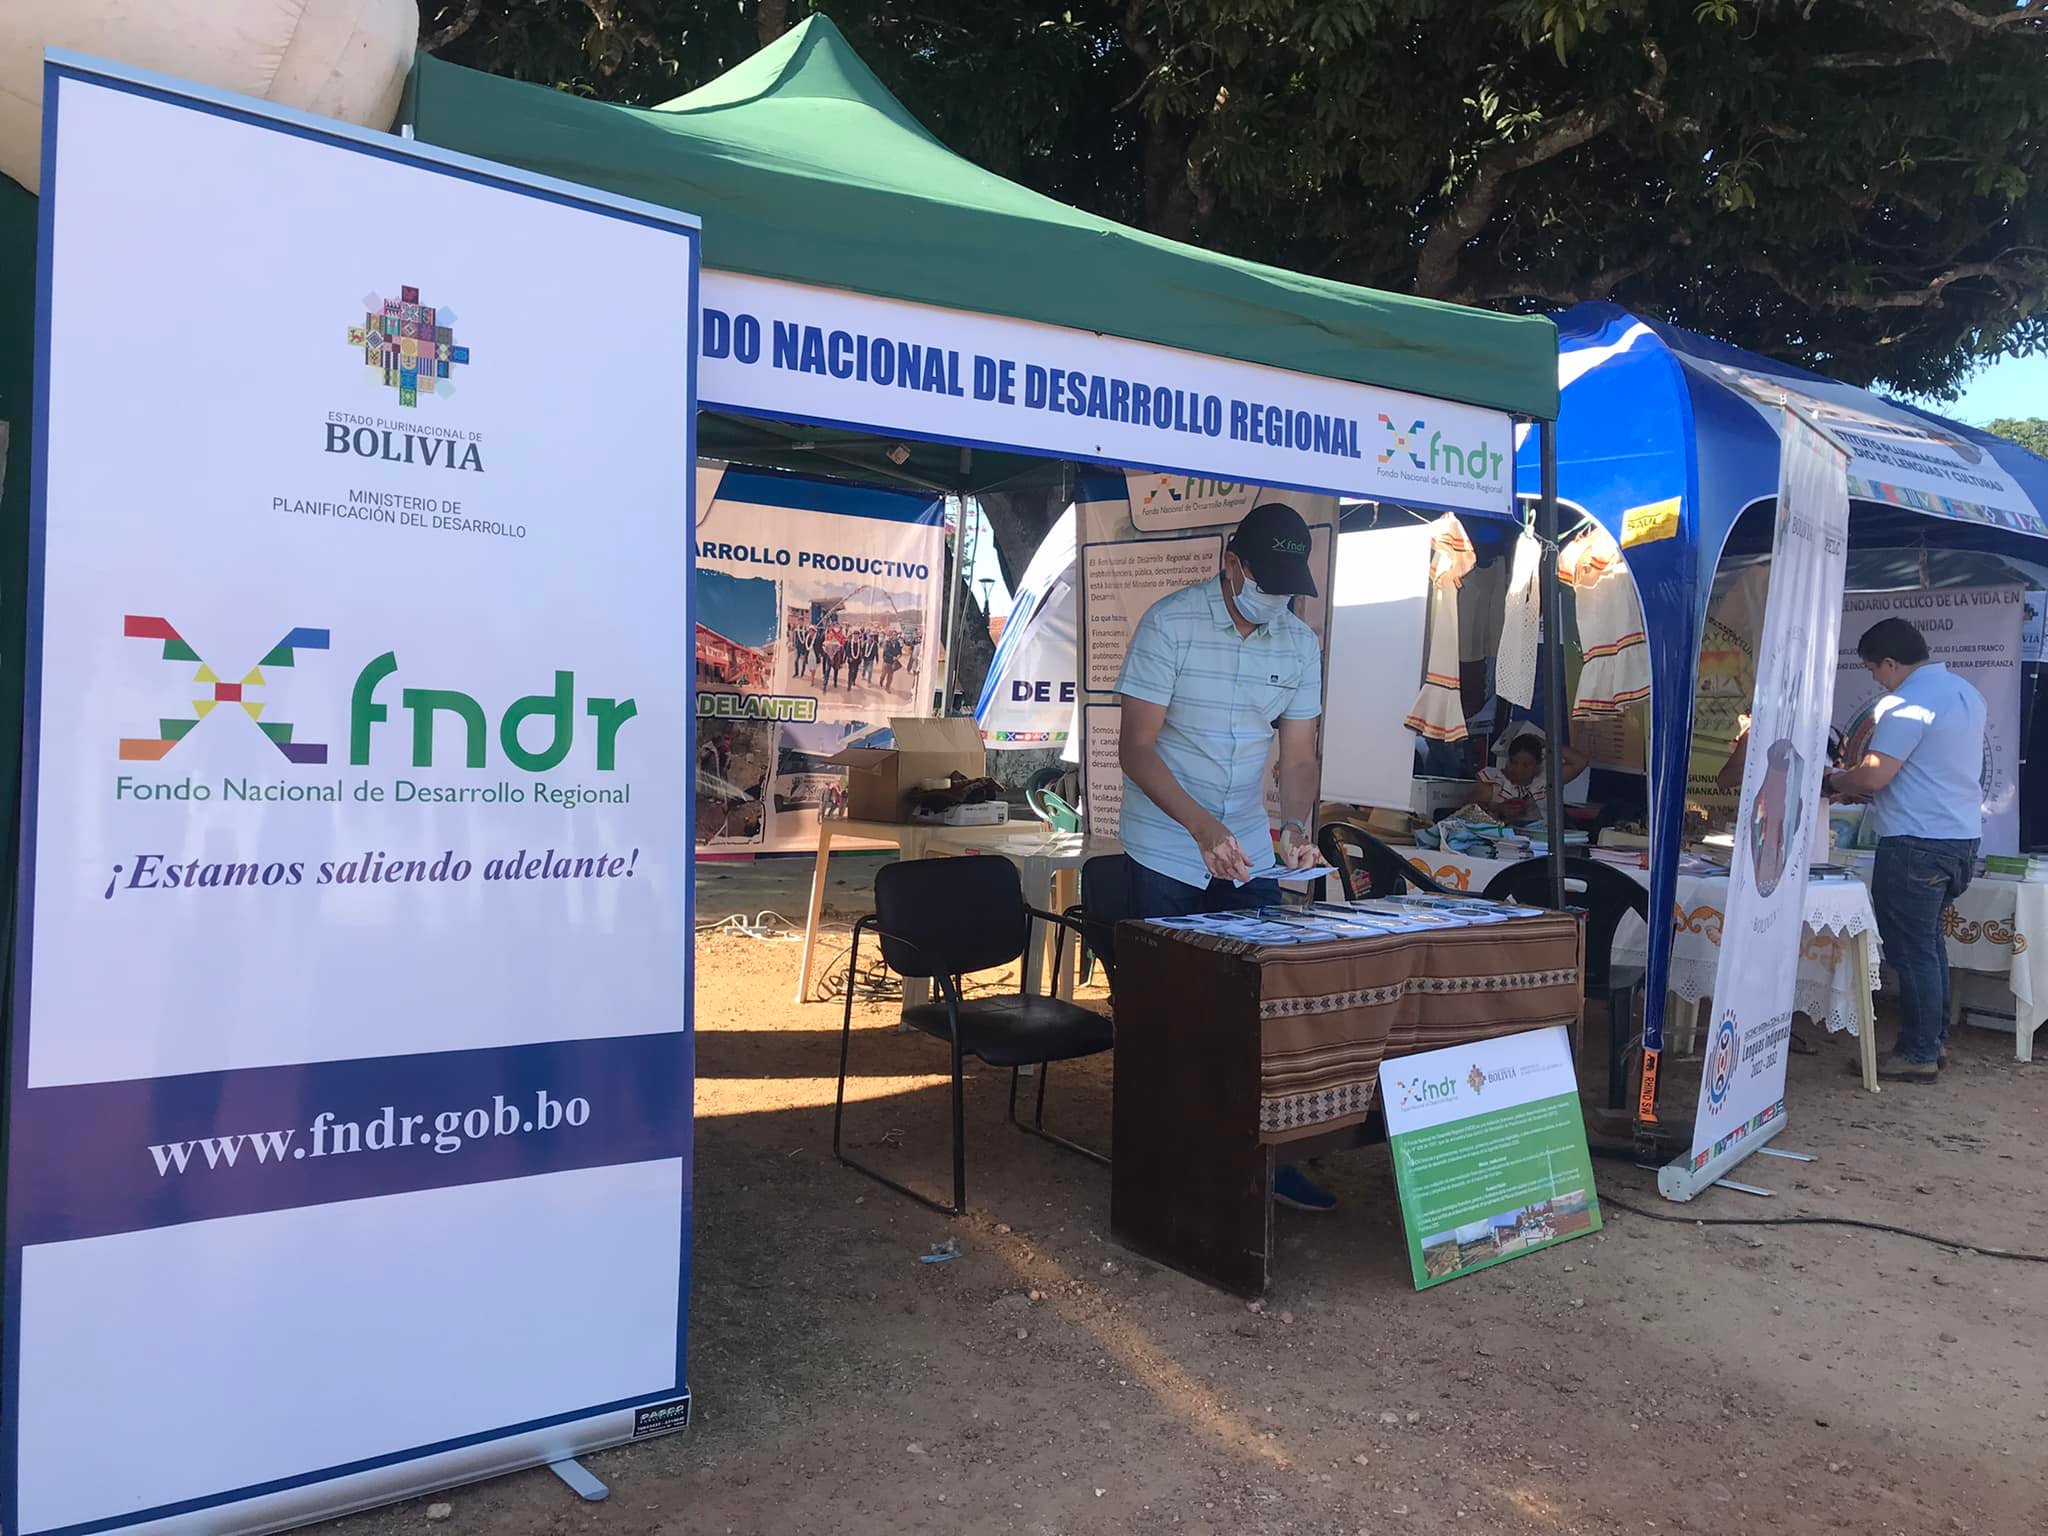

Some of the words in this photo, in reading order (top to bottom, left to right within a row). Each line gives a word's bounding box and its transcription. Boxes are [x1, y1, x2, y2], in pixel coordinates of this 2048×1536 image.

[773, 320, 964, 397] NACIONAL
[973, 353, 1015, 405] DE
[1025, 363, 1222, 437] DESARROLLO
[1230, 400, 1361, 459] REGIONAL
[328, 411, 374, 426] ESTADO
[376, 418, 466, 440] PLURINACIONAL
[468, 432, 483, 442] DE
[325, 422, 485, 473] BOLIVIA
[1430, 430, 1503, 481] fndr
[273, 497, 396, 524] PLANIFICACIÓN
[400, 511, 428, 528] DEL
[433, 515, 526, 539] DESARROLLO
[349, 489, 437, 512] MINISTERIO
[442, 501, 462, 515] DE
[799, 551, 929, 581] PRODUCTIVO
[1936, 594, 1951, 607] DE
[1952, 593, 1969, 606] LA
[1970, 592, 2001, 606] VIDA
[2004, 591, 2020, 604] EN
[696, 695, 814, 719] DELANTE!
[1012, 680, 1051, 702] DE
[350, 650, 638, 772] fndr
[117, 776, 210, 801] Fondo
[223, 778, 342, 802] Nacional
[354, 780, 384, 802] de
[395, 780, 525, 803] Desarrollo
[534, 782, 630, 809] Regional
[104, 854, 305, 900] ¡Estamos
[317, 850, 472, 884] saliendo
[483, 848, 639, 882] adelante!
[1422, 1076, 1456, 1100] fndr
[148, 1090, 590, 1177] www.fndr.gob.bo
